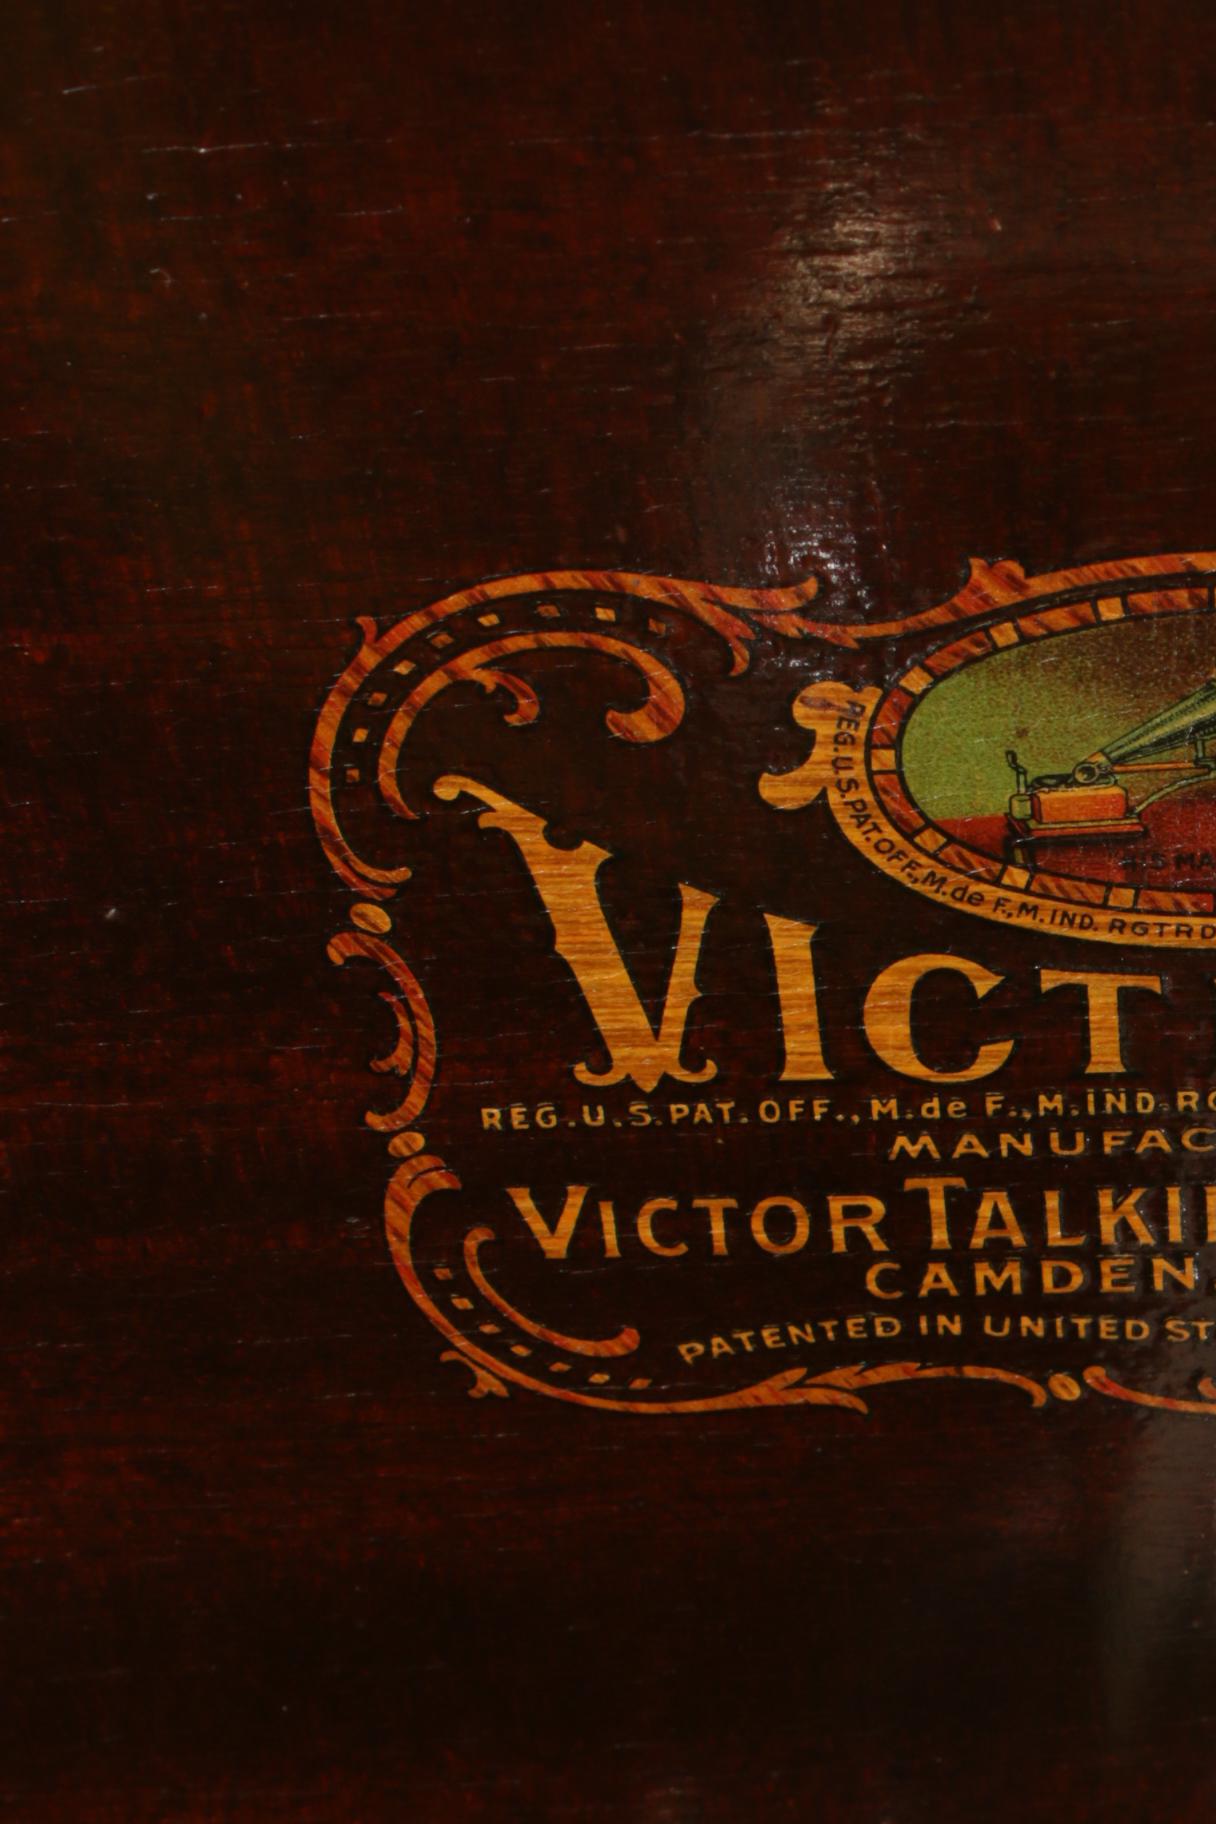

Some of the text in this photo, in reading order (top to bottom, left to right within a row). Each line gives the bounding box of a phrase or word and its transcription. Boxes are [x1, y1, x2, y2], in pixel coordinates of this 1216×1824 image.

[951, 885, 985, 907] de
[920, 1096, 968, 1119] de
[505, 1185, 890, 1259] VICTOR
[677, 1315, 901, 1364] PATENTED
[920, 1314, 962, 1338] IN
[984, 1316, 1150, 1340] UNITED
